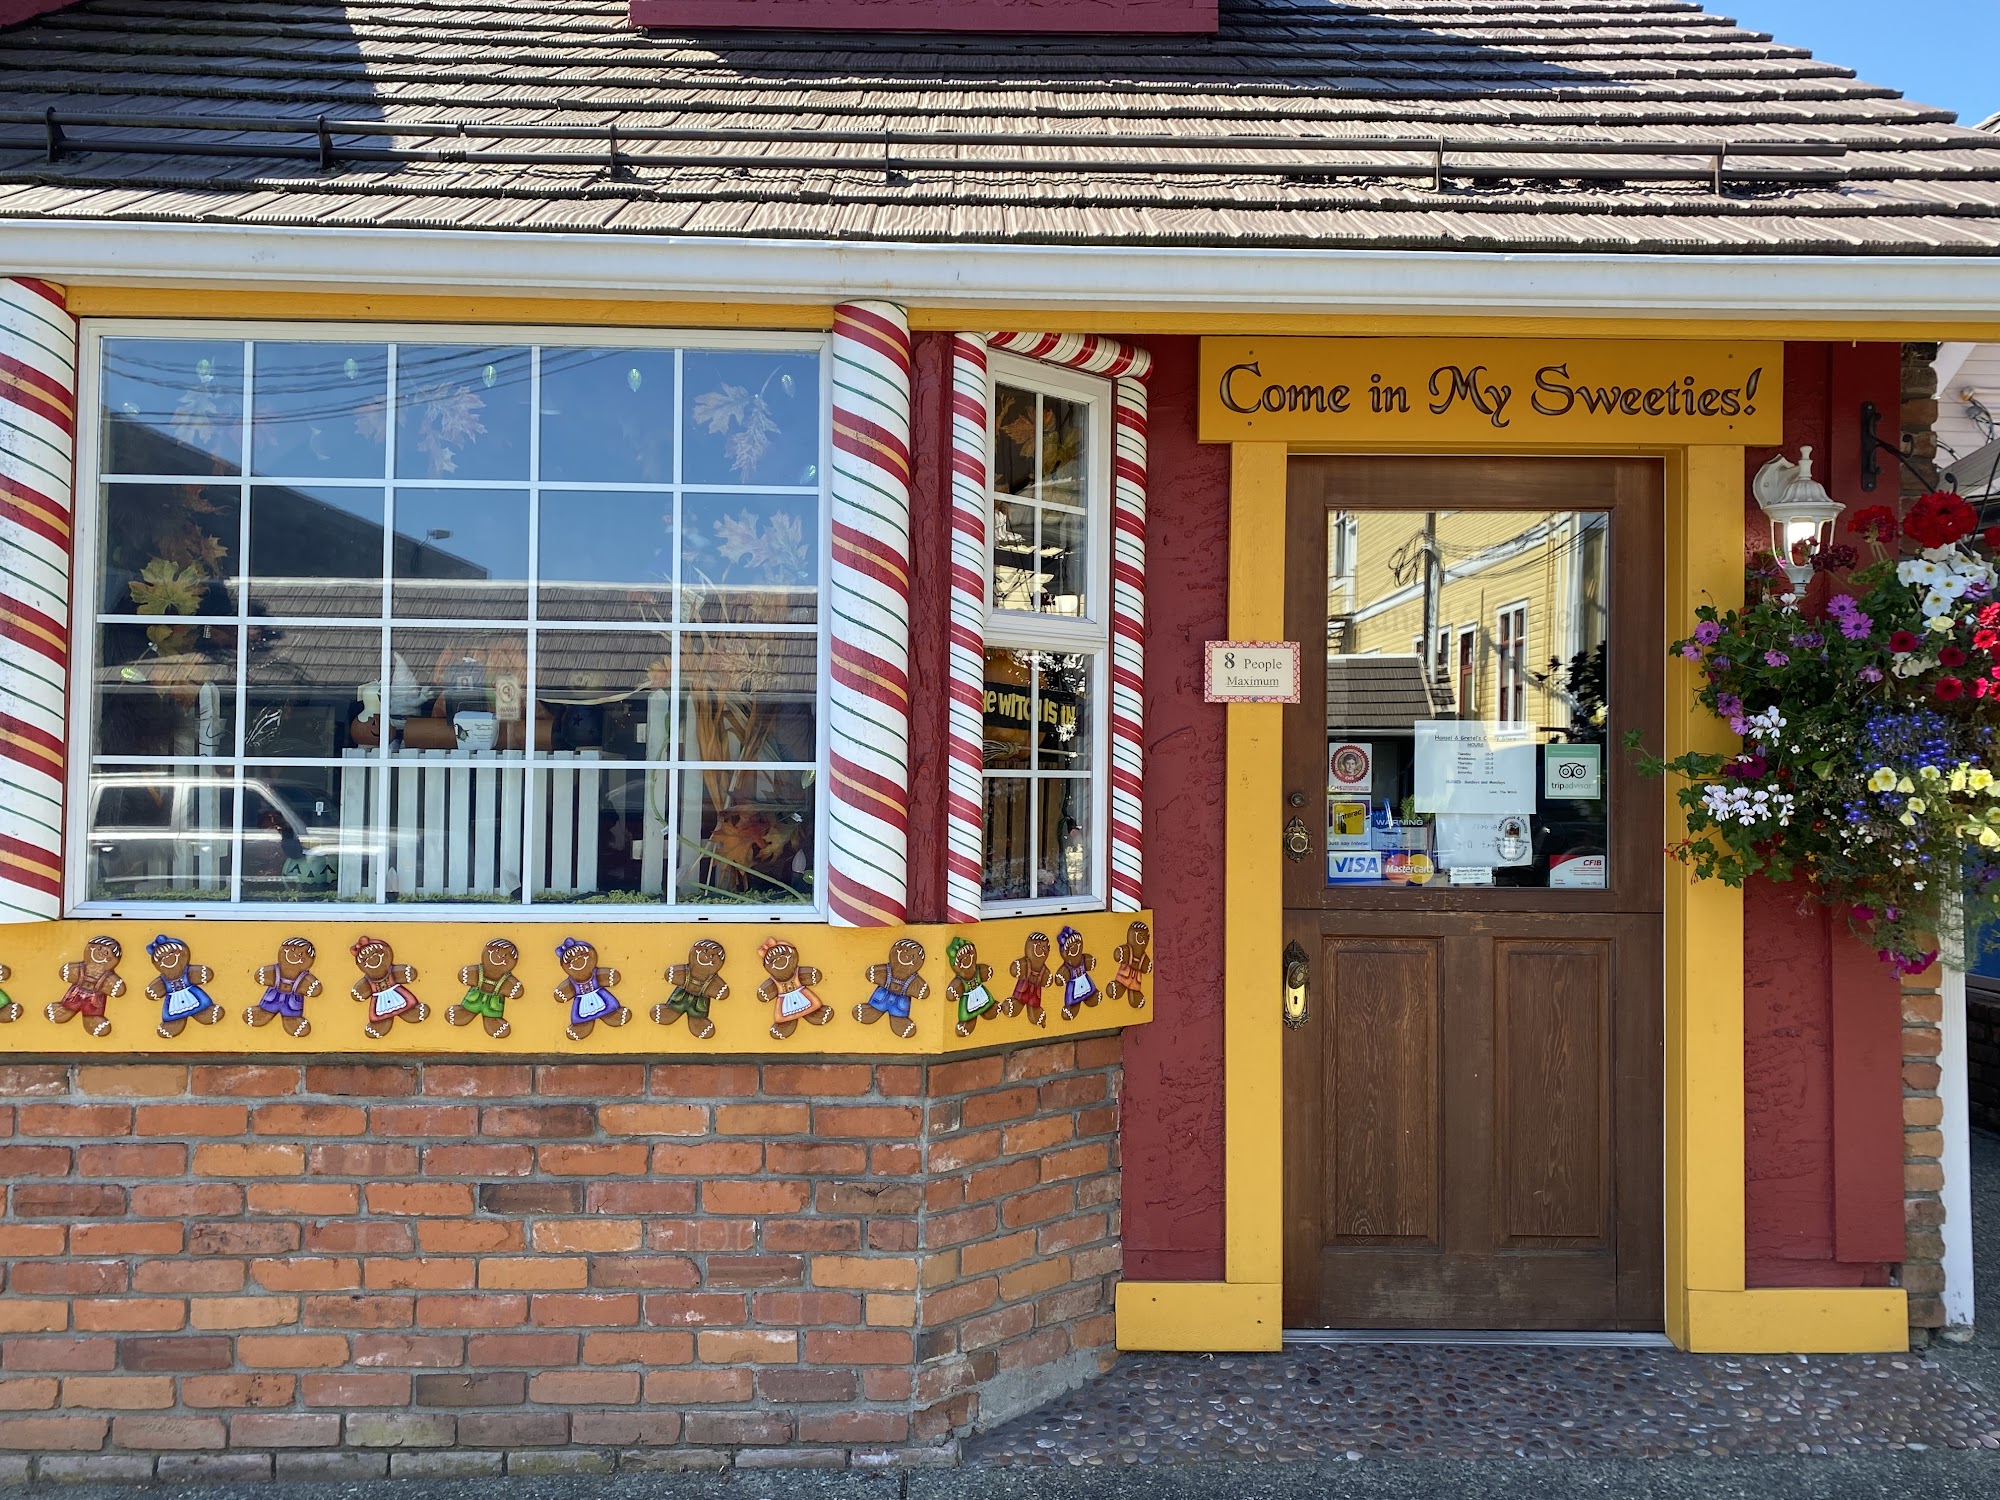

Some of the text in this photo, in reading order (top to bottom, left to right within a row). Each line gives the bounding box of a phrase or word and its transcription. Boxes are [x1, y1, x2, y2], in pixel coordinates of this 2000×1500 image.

[1218, 361, 1763, 428] Come in My Sweeties!
[1224, 652, 1283, 672] 8 People
[1226, 676, 1279, 687] Maximum
[1043, 698, 1058, 725] IS
[1551, 782, 1593, 790] tripadvisor
[1335, 857, 1379, 873] VISA
[1386, 864, 1434, 874] MasterCard
